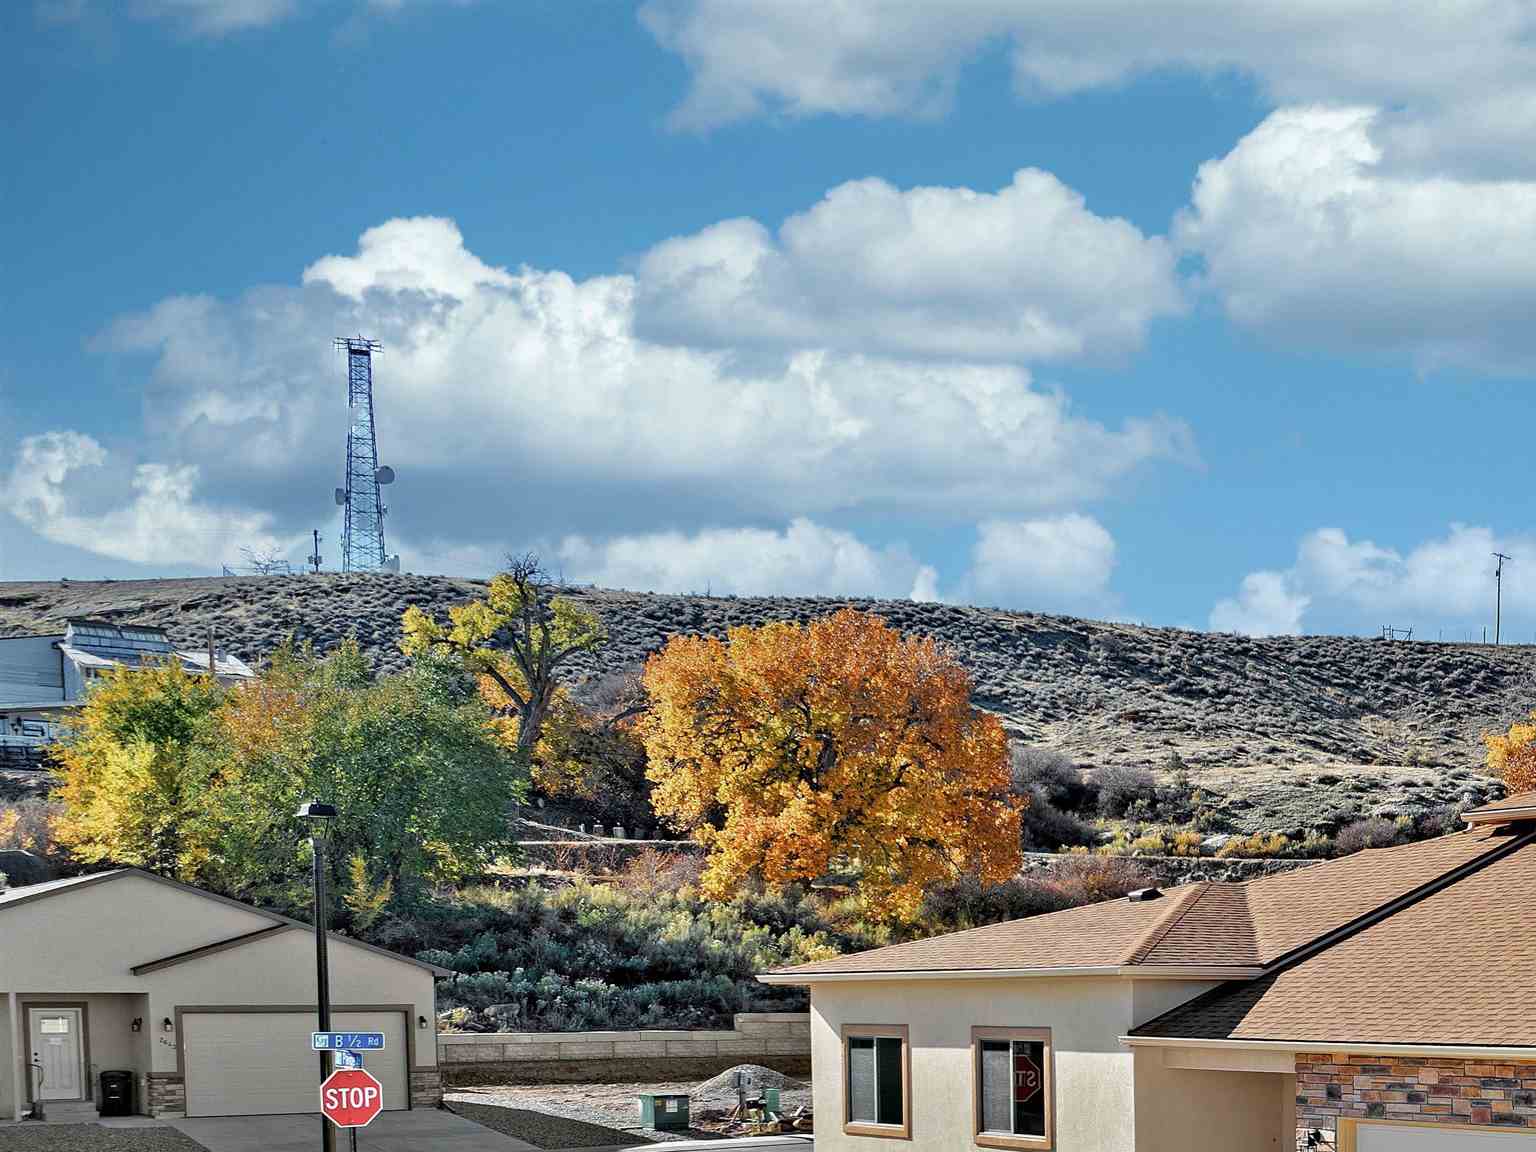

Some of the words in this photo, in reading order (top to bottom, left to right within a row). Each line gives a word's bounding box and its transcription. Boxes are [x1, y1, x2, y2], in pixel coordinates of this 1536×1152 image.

[336, 1035, 343, 1048] B
[368, 1037, 379, 1046] Rd
[326, 1087, 378, 1109] STOP
